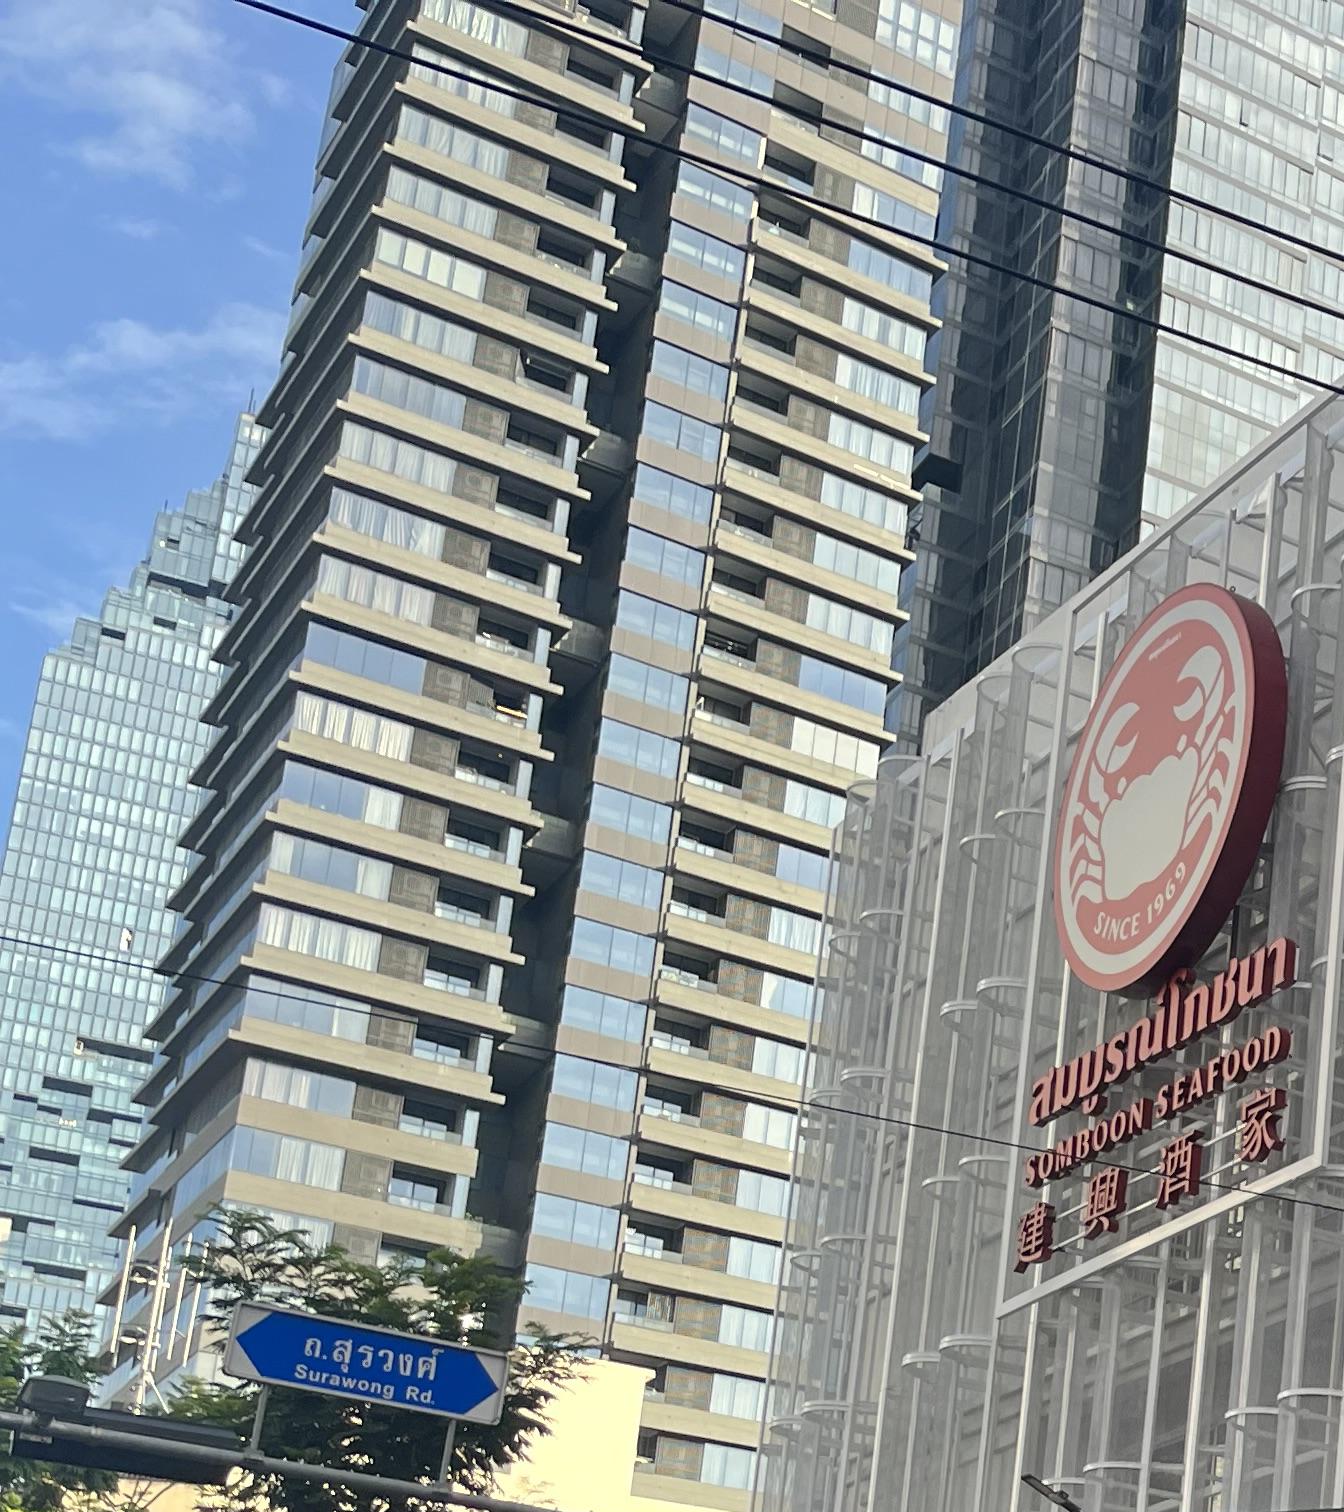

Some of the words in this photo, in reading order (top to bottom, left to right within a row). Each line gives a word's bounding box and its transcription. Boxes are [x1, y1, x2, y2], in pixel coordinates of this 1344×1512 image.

[1094, 911, 1141, 943] SINCE
[1147, 862, 1186, 925] 1969
[1025, 1100, 1151, 1187] SOMBOON
[1156, 1026, 1288, 1118] SEAFOOD
[294, 1363, 395, 1400] Surawong
[406, 1385, 435, 1406] Rd.
[303, 1337, 444, 1382] ถ.สุรวงศ์
